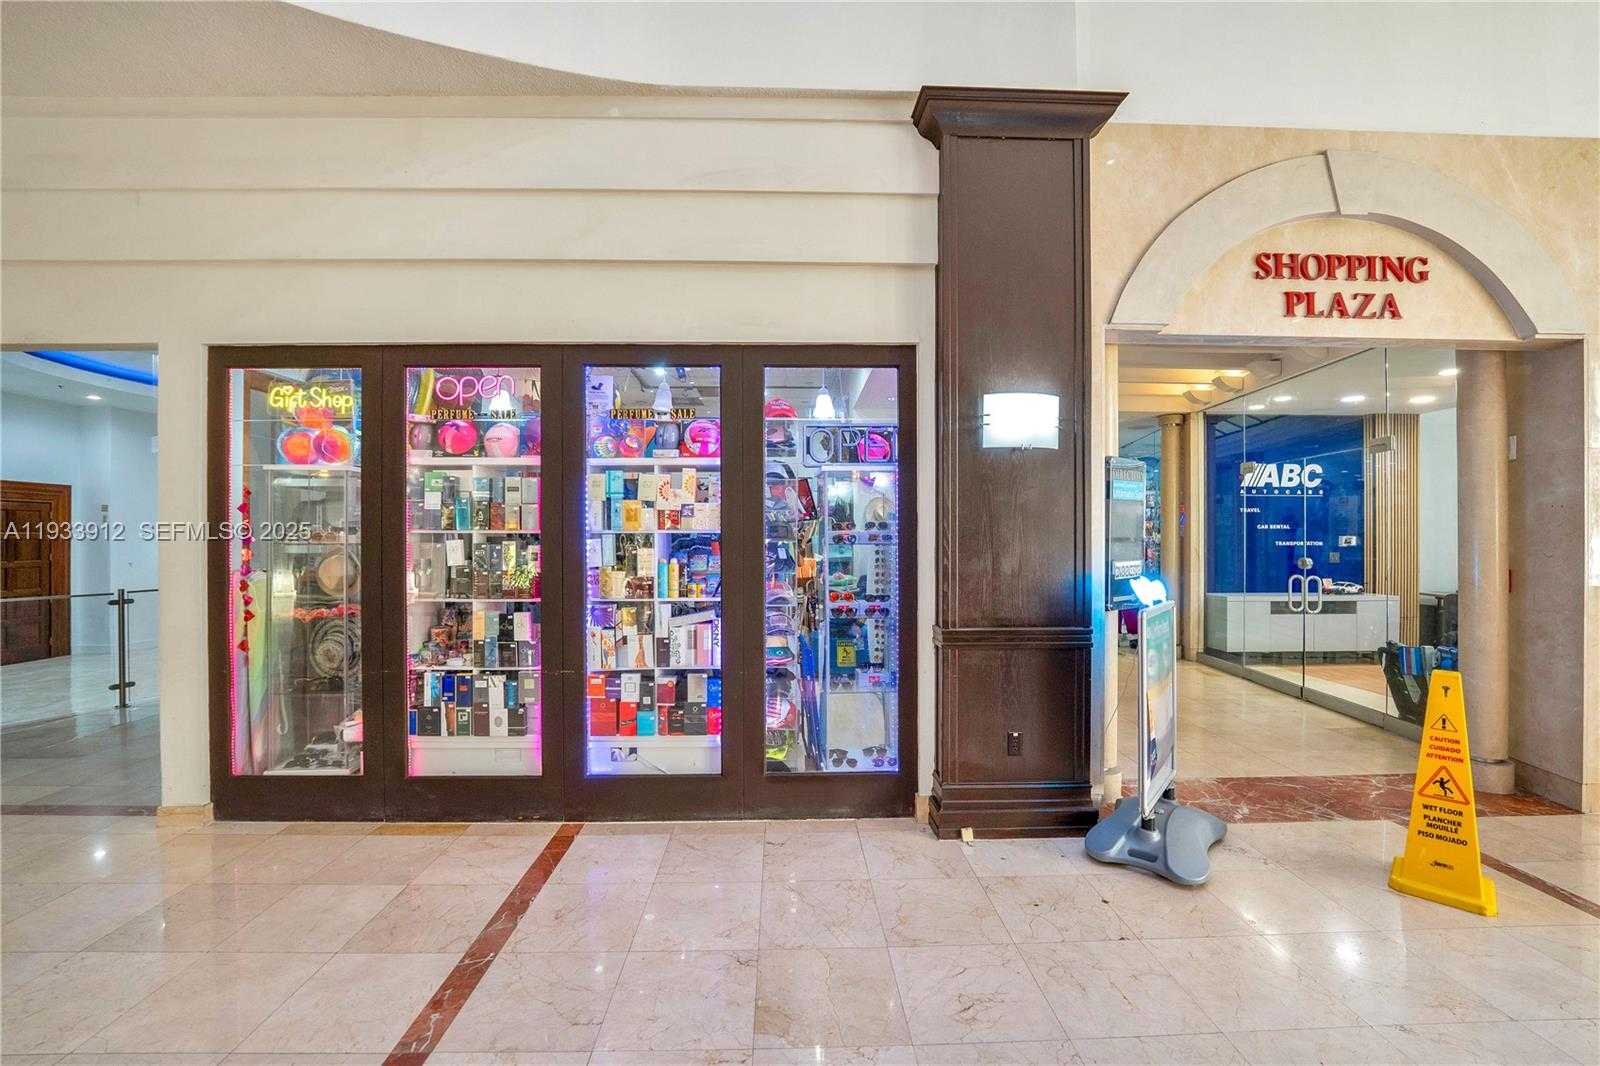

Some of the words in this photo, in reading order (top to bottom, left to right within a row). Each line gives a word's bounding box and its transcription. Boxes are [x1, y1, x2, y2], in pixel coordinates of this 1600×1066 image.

[1254, 252, 1430, 284] SHOPPING
[1283, 291, 1403, 320] PLAZA
[436, 375, 516, 406] open
[269, 385, 307, 414] Gift
[309, 386, 354, 414] Shop
[431, 408, 474, 420] PERFUME
[610, 408, 655, 420] PERFUME
[670, 408, 697, 420] SALE
[809, 427, 898, 463] OPE
[1257, 463, 1324, 488] ABC
[1430, 736, 1461, 745] CAUTION
[1428, 744, 1462, 754] CUIDADO
[1426, 753, 1464, 763] ATTENTION
[1422, 803, 1438, 813] WET
[1438, 806, 1464, 818] FLOOR
[1423, 814, 1462, 828] PLANCHER
[1418, 830, 1435, 839] PISO
[1436, 834, 1468, 846] MOJADO
